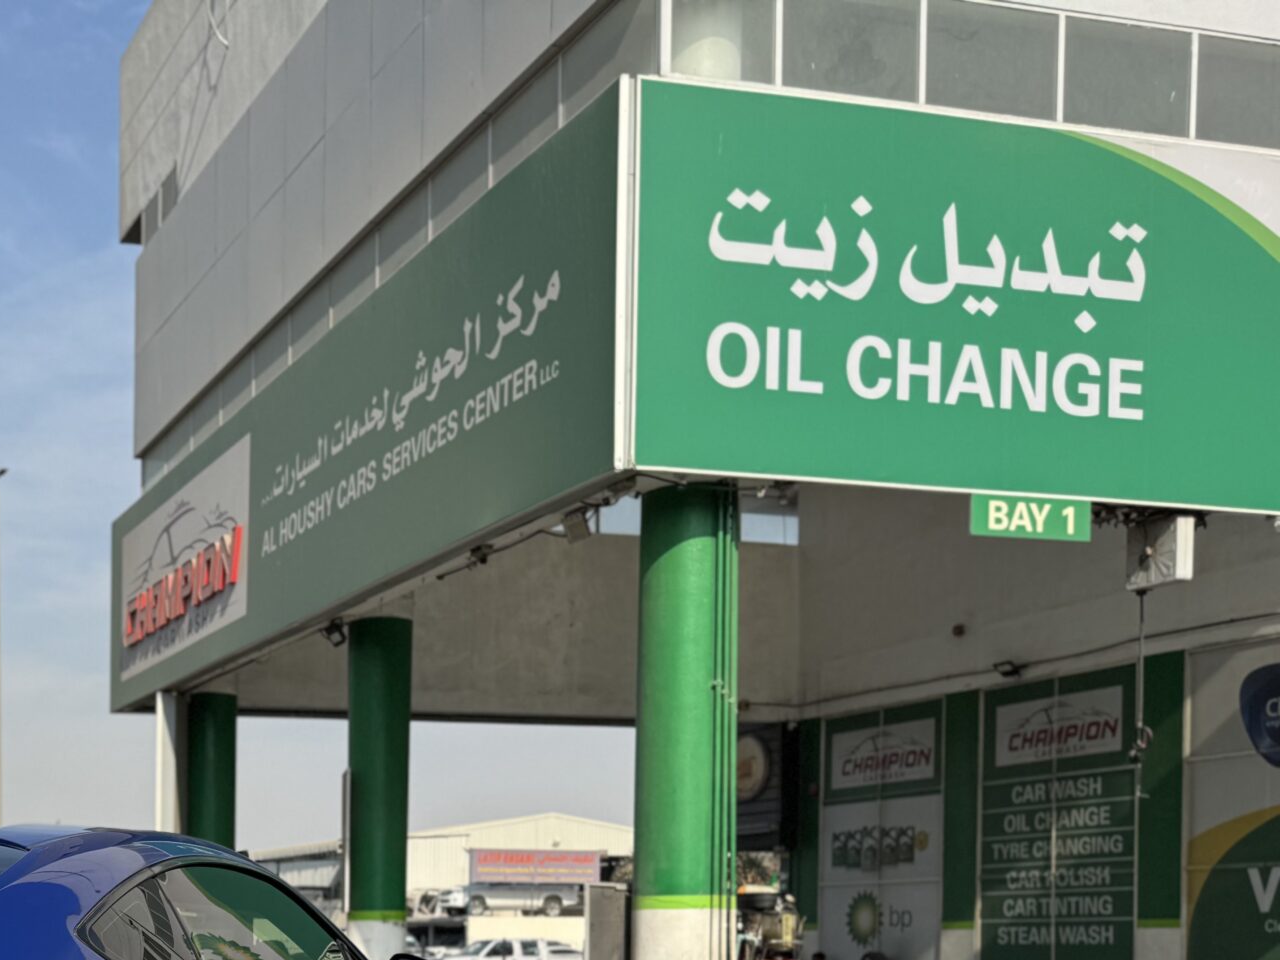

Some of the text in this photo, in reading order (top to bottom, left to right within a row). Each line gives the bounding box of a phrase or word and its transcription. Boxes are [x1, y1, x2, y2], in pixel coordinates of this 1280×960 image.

[708, 187, 1148, 334] تبديل زيت
[484, 269, 561, 361] مركز
[392, 312, 481, 432] الحوشي
[706, 321, 1145, 421] OIL CHANGE
[330, 387, 390, 457] لخدمات
[261, 358, 560, 558] AL HOUSHY CARS SERVICES CENTER LLC
[272, 433, 328, 497] السيارات
[987, 499, 1075, 536] BAY 1
[123, 523, 244, 648] CHAMPION
[1008, 717, 1119, 753] CHAMPION
[841, 747, 932, 777] CHAMPION
[1011, 776, 1103, 804] CAR WASH
[1003, 806, 1111, 833] OIL CHANGE
[991, 834, 1124, 861] TYRE CHANGING
[1005, 869, 1041, 890] CAR
[889, 904, 913, 932] bp
[1002, 894, 1114, 918] CAR TNTING
[1058, 924, 1115, 946] WASH
